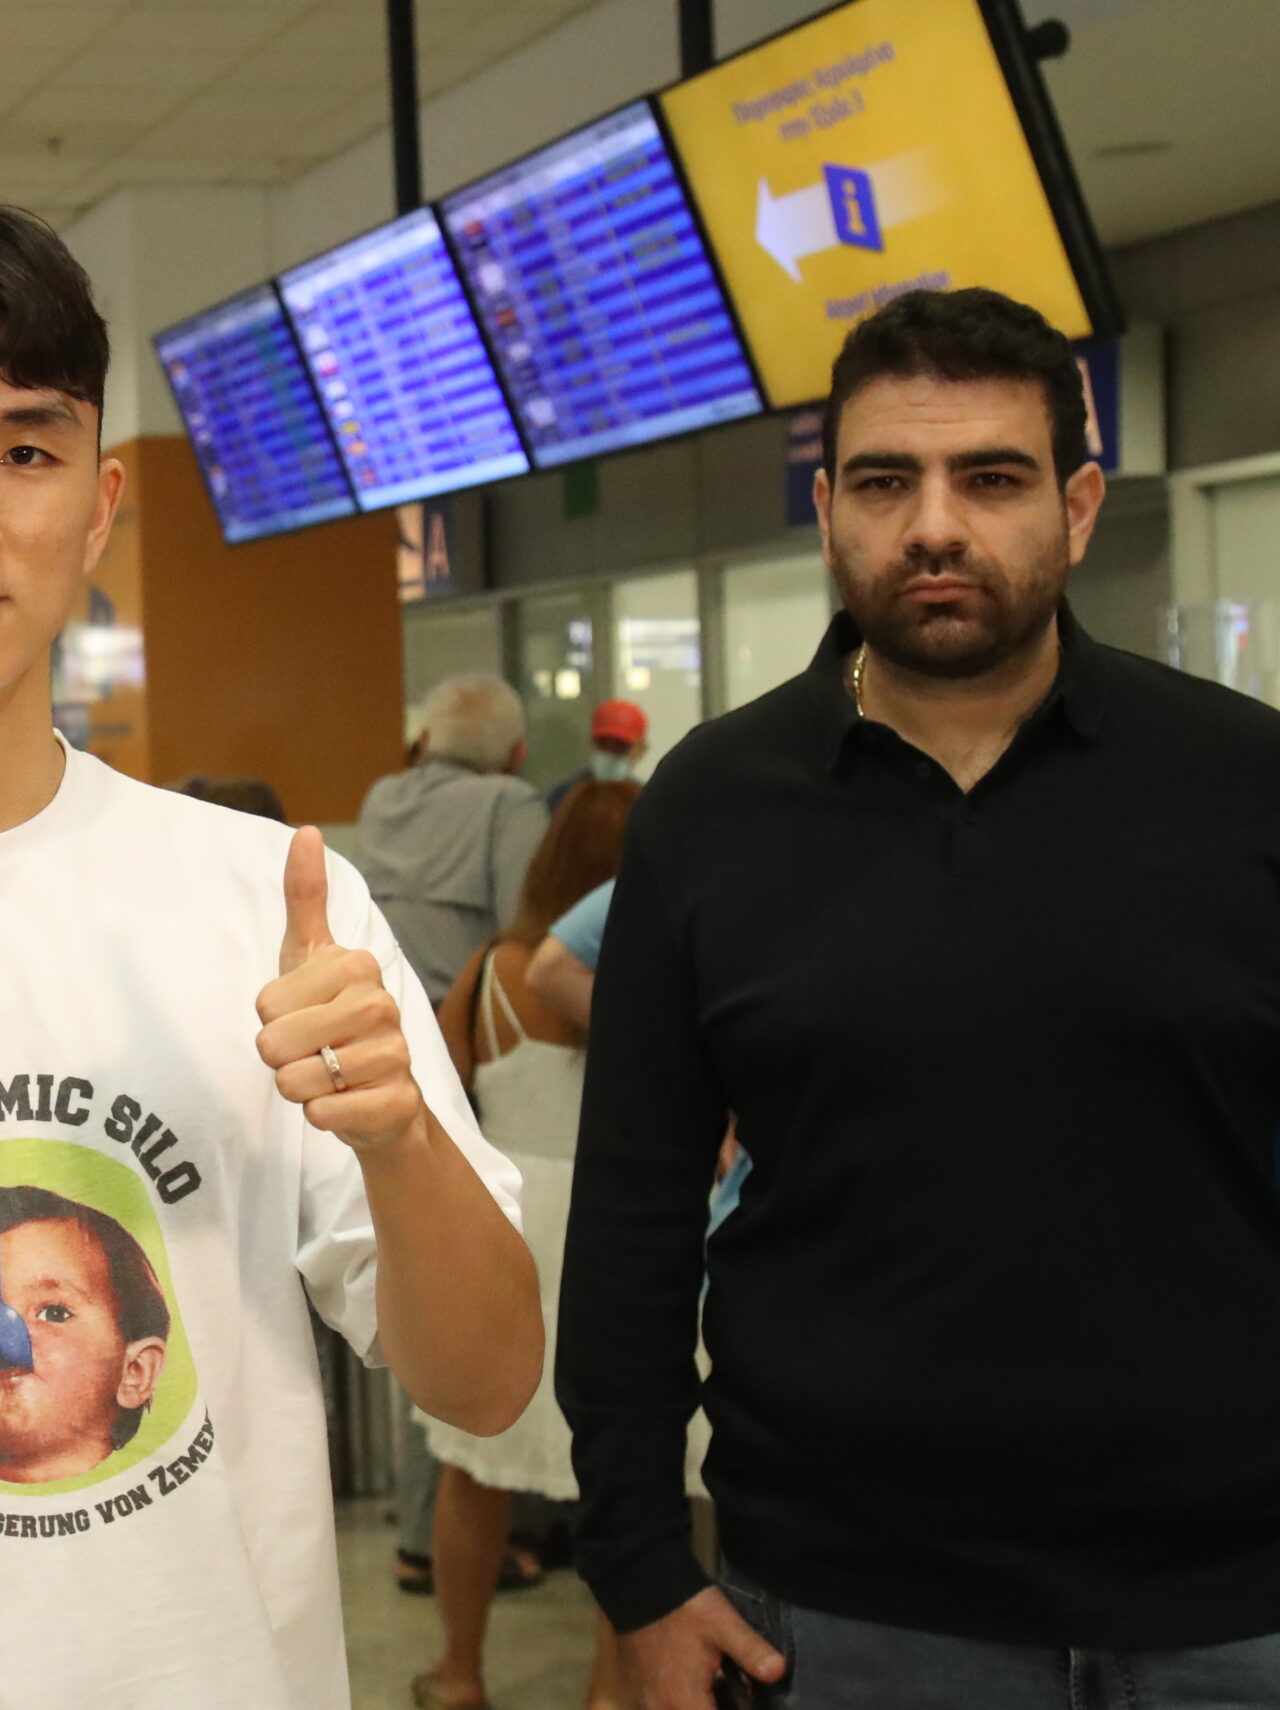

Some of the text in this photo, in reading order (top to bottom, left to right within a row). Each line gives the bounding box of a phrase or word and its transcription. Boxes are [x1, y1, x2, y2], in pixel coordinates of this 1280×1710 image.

[104, 1093, 202, 1205] SILO
[94, 1484, 153, 1524] VON
[147, 1400, 215, 1496] ZEMEN
